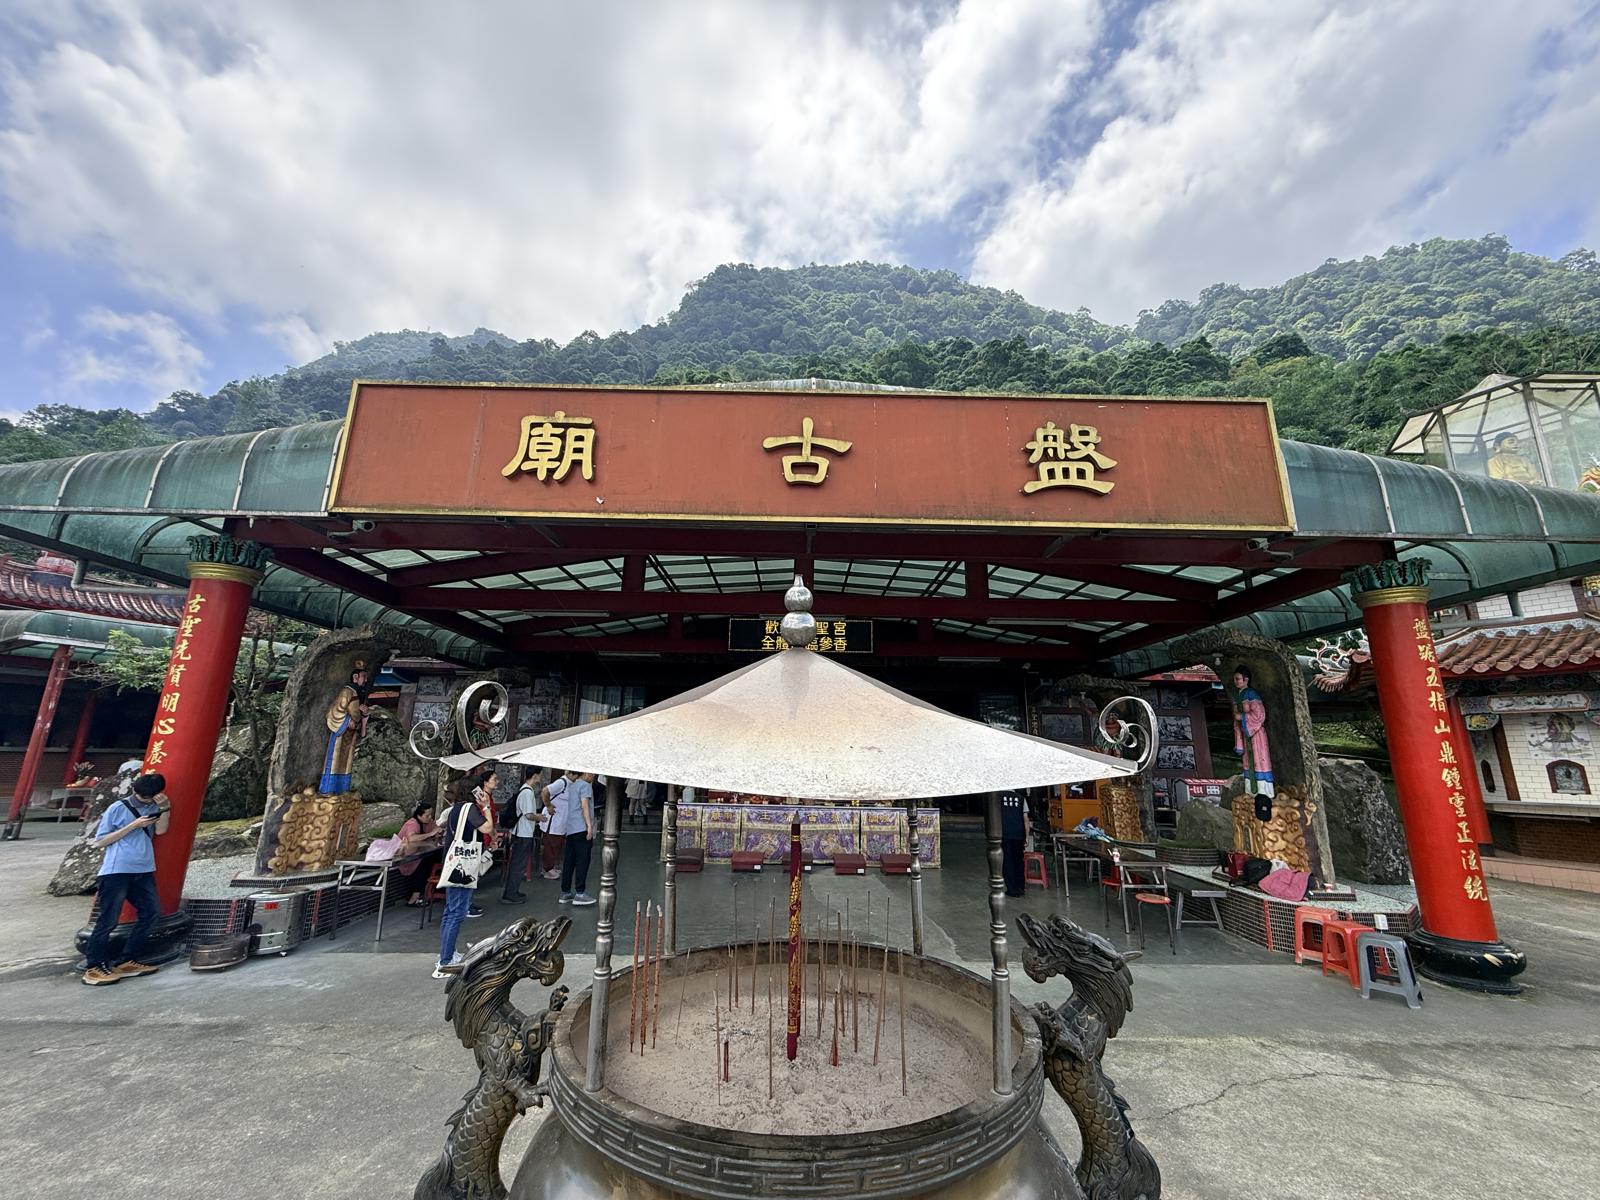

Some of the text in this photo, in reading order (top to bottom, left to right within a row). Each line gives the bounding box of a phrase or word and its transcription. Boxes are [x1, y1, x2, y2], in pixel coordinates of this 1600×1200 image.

[765, 620, 847, 636] 歡聖宮
[761, 635, 848, 651] 全體臨參香
[144, 594, 206, 776] 古聖先賢明心養
